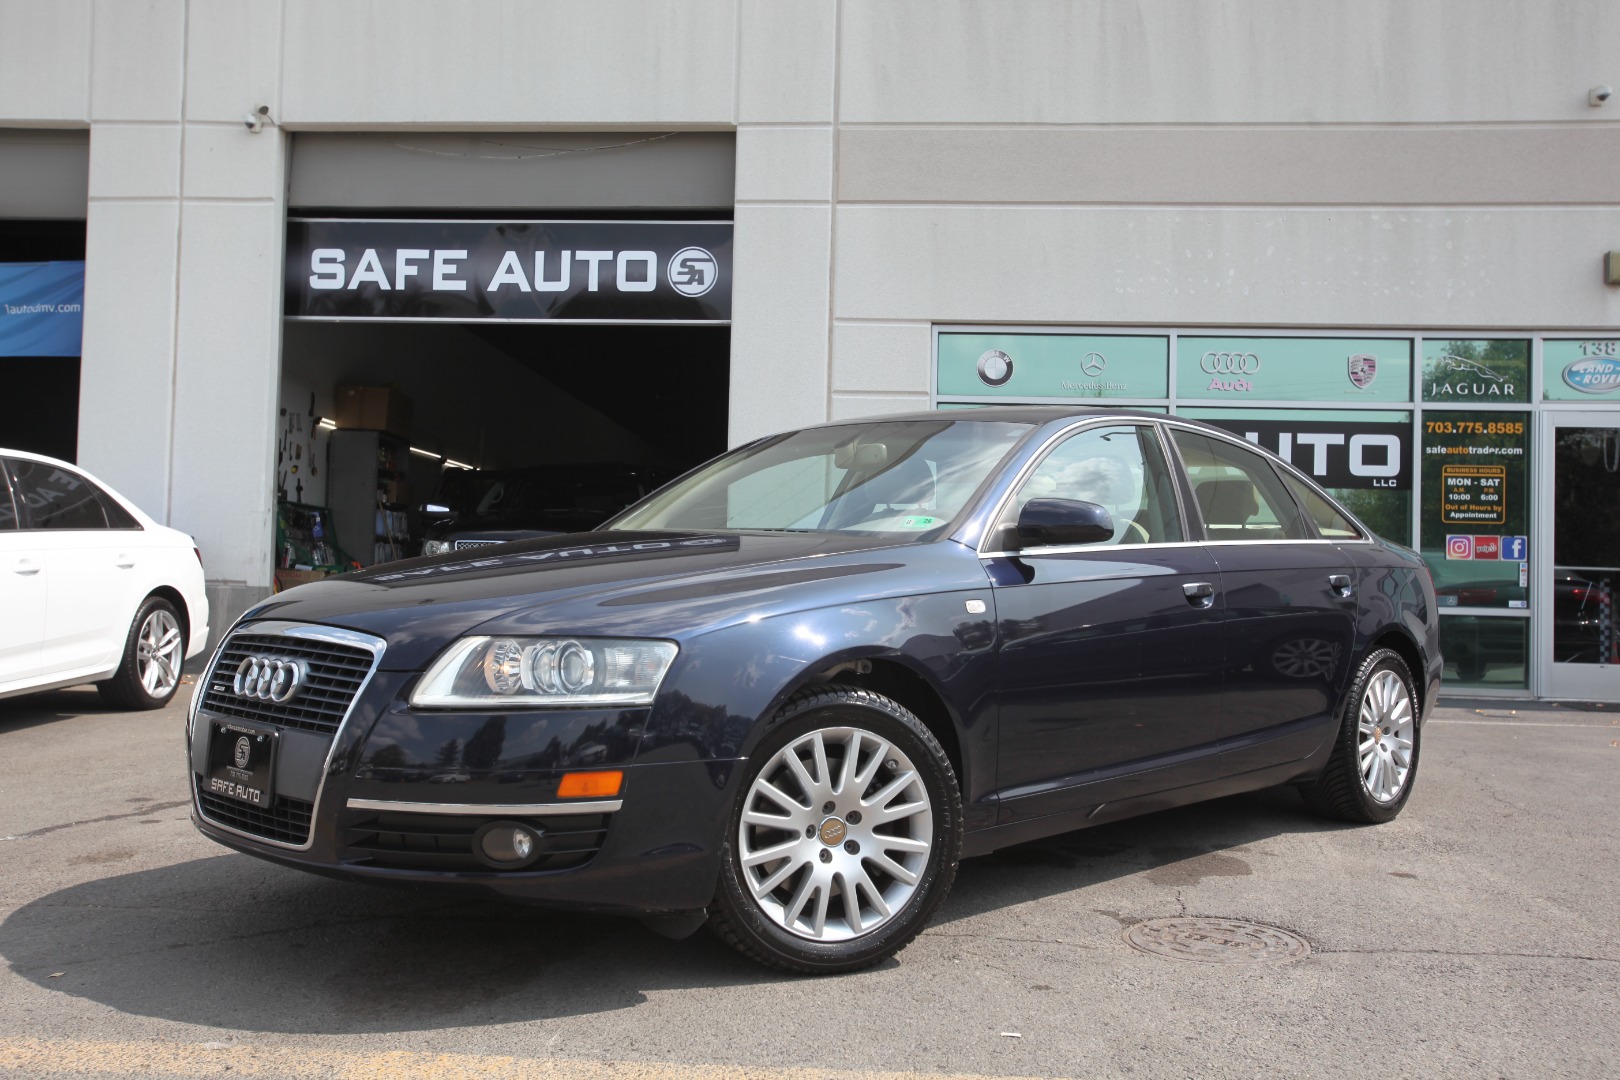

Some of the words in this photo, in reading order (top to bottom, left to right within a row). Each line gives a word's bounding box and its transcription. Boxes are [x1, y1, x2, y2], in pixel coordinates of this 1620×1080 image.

[309, 248, 468, 291] SAFE
[487, 250, 657, 292] AUTO
[4, 303, 81, 315] 1autodmv.com
[1060, 381, 1129, 391] Mercedes-Benz
[1207, 378, 1253, 391] Audi
[1431, 383, 1515, 397] JAGUAR
[1426, 421, 1524, 434] 703.775.8585
[1426, 445, 1523, 456] safeautotrader.com
[1373, 479, 1397, 487] LLC
[1447, 478, 1471, 486] MON
[1480, 479, 1500, 487] SAT
[210, 777, 236, 796] SAFE
[235, 784, 261, 803] AUTO
